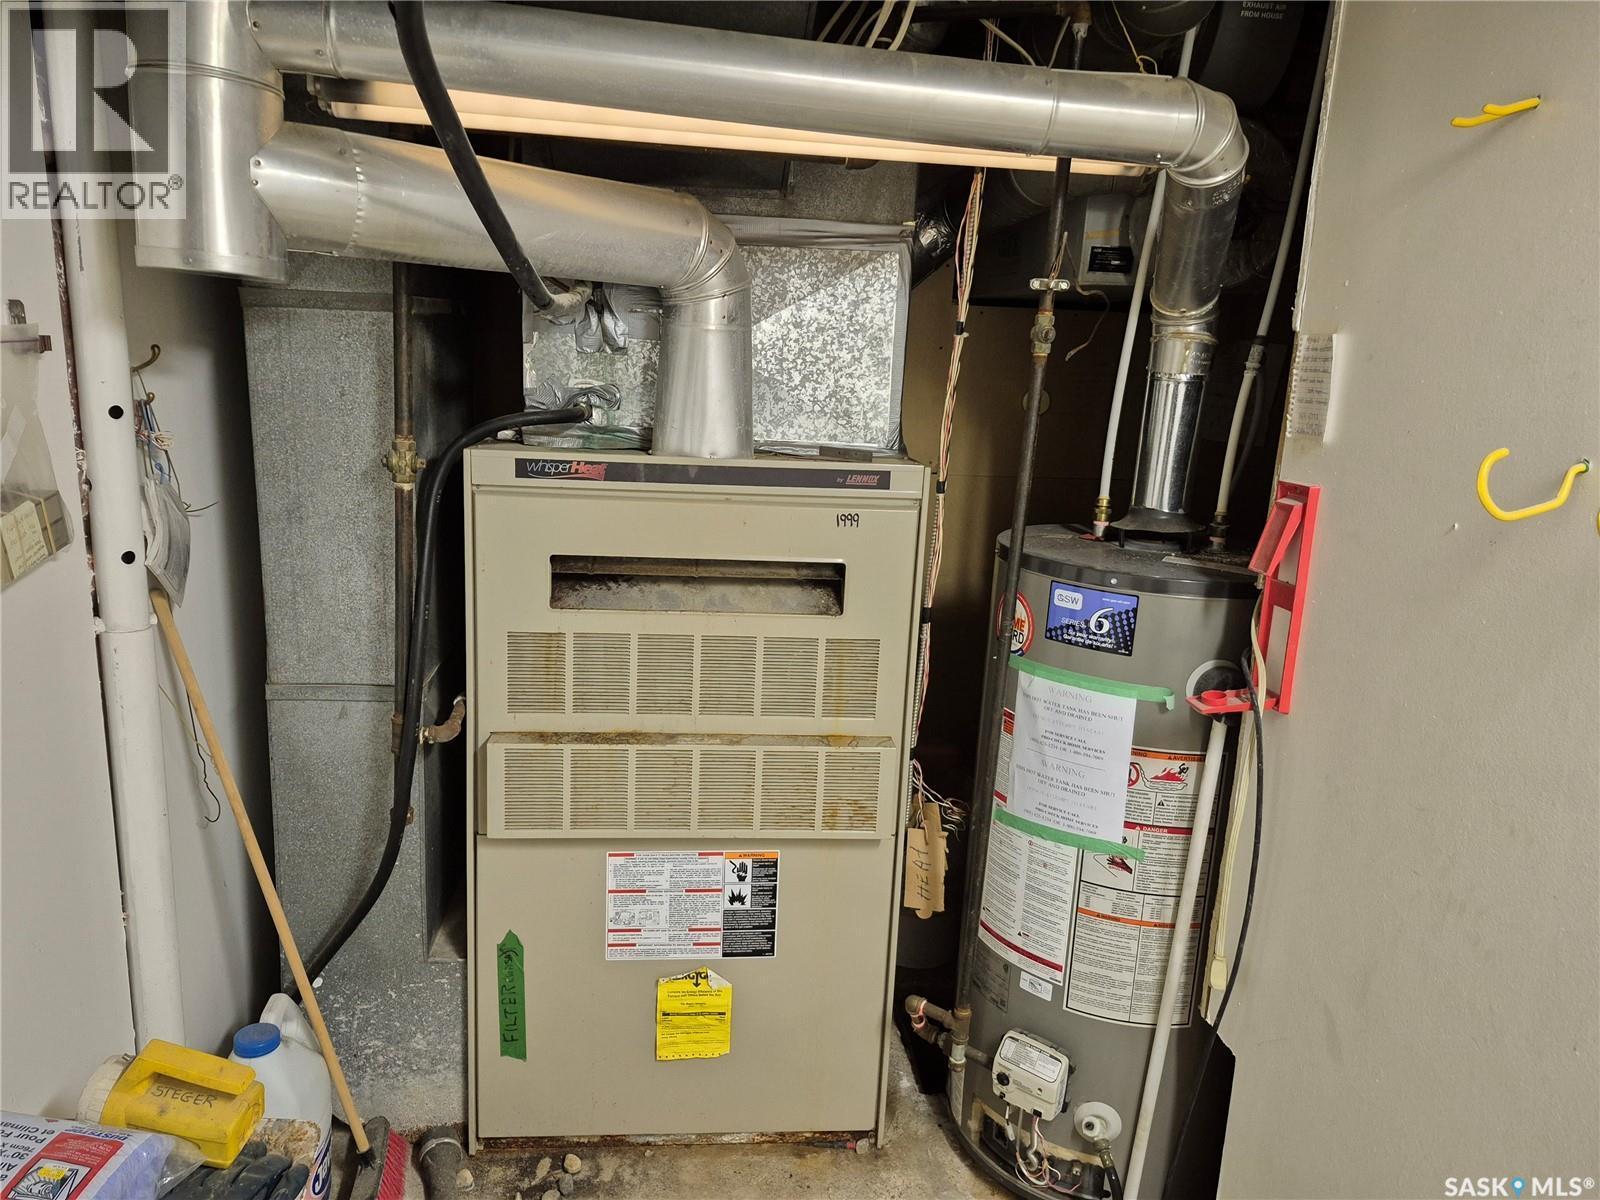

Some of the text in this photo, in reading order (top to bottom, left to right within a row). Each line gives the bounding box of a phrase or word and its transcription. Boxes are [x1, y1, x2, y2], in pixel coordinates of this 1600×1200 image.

[1242, 1, 1273, 9] EXHAUST
[1240, 10, 1285, 19] FROM HOUSE
[847, 474, 880, 484] LENNOX
[836, 512, 860, 528] 1999
[1056, 593, 1080, 606] GSW
[1089, 607, 1114, 634] 6
[1048, 687, 1093, 704] WARNING
[1043, 699, 1061, 708] WATER
[1062, 704, 1077, 713] TANK
[1090, 711, 1107, 719] BEEN
[1041, 760, 1086, 779] WARNING
[1037, 771, 1054, 781] WATER
[1055, 778, 1070, 787] TANK
[1083, 786, 1099, 794] BEEN
[1060, 786, 1086, 797] DRAINED
[1142, 825, 1168, 834] DANGER
[909, 846, 932, 901] HEAT
[501, 984, 519, 1043] FILTER
[151, 1084, 218, 1110] STEGER
[14, 1132, 47, 1144] Pour
